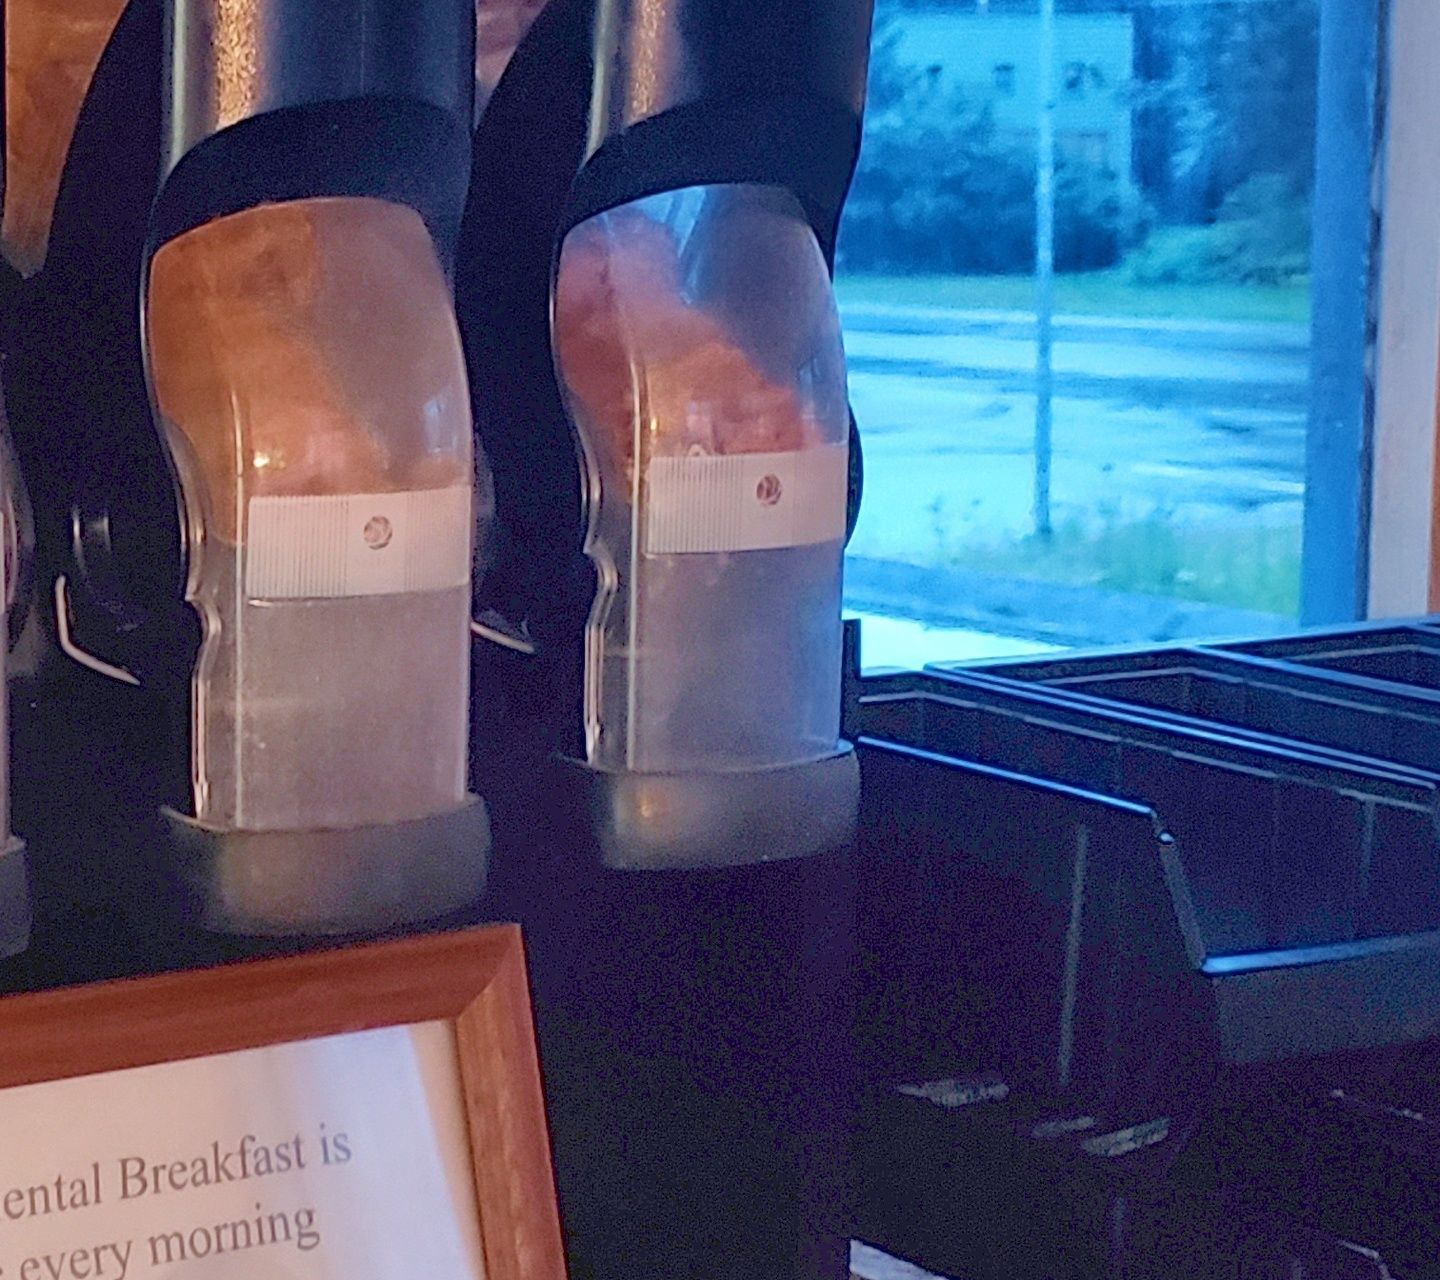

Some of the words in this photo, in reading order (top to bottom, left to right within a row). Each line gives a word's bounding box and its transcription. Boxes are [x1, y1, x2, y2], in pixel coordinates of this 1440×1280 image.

[118, 1133, 306, 1201] Breakfast
[320, 1122, 352, 1166] is
[147, 1202, 322, 1267] morning
